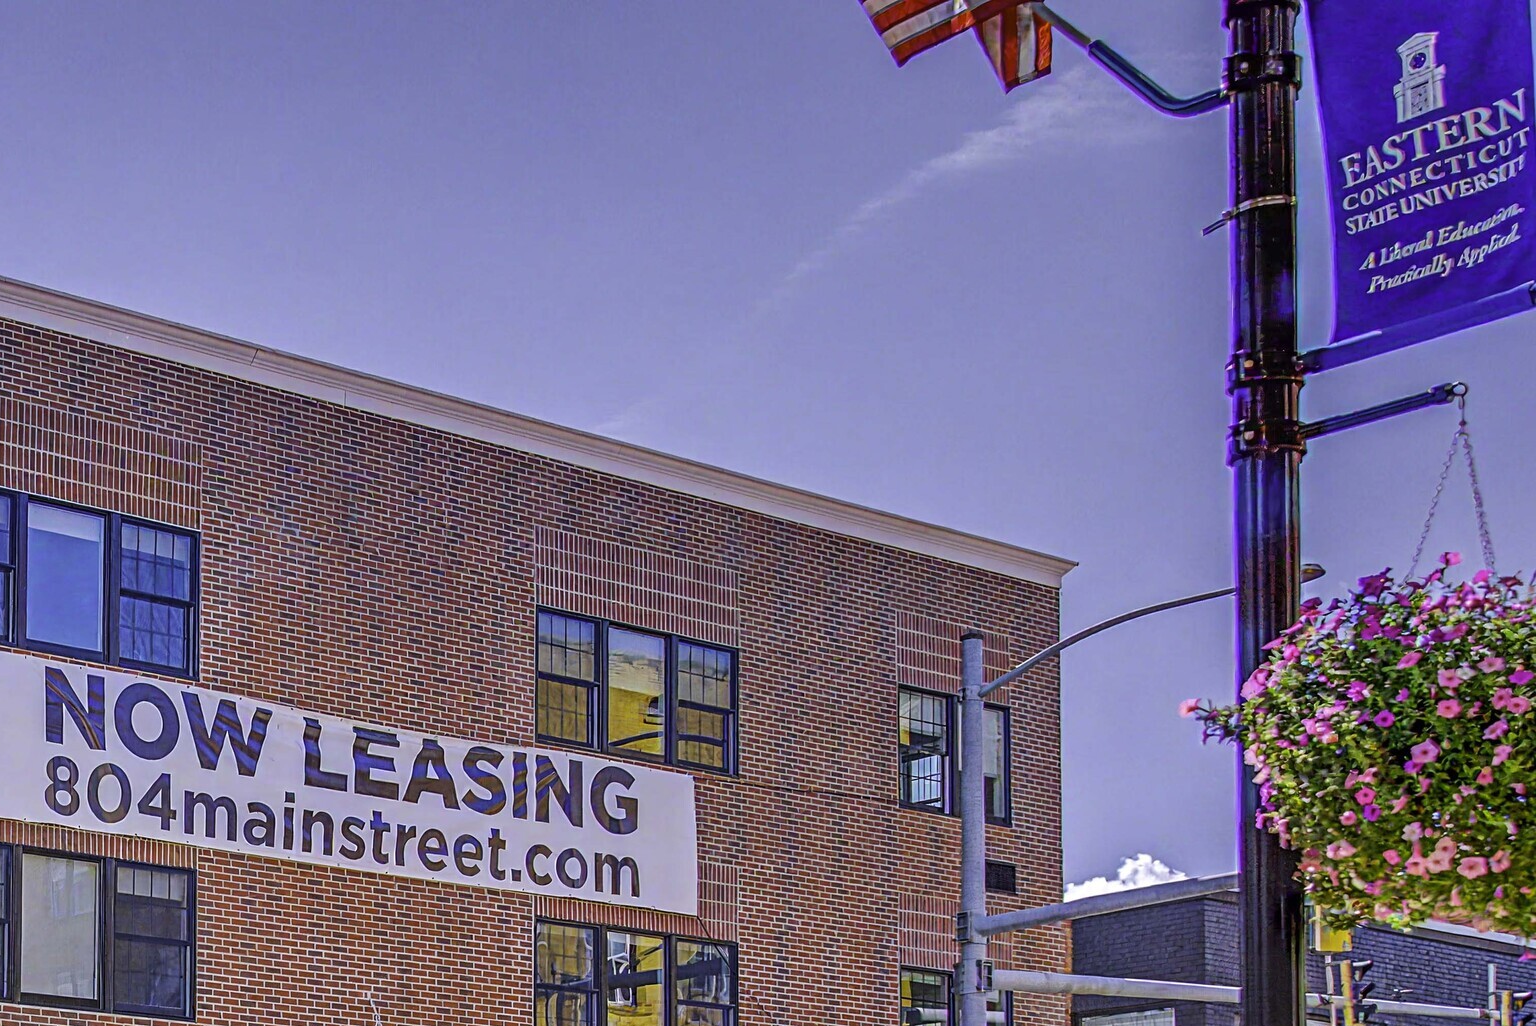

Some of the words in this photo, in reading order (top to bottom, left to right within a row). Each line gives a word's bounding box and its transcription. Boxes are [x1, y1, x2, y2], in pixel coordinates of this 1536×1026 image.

[1338, 88, 1526, 189] EASTERN
[1342, 127, 1530, 210] CONNECTICUT
[1345, 202, 1399, 235] STATE
[1400, 152, 1527, 214] UNIVERSITY
[1359, 252, 1376, 270] A
[1379, 231, 1434, 266] Liberal
[1367, 252, 1454, 293] Practically
[45, 667, 272, 777] NOW
[302, 717, 640, 835] LEASING
[45, 755, 641, 898] 804mainstreet.com
